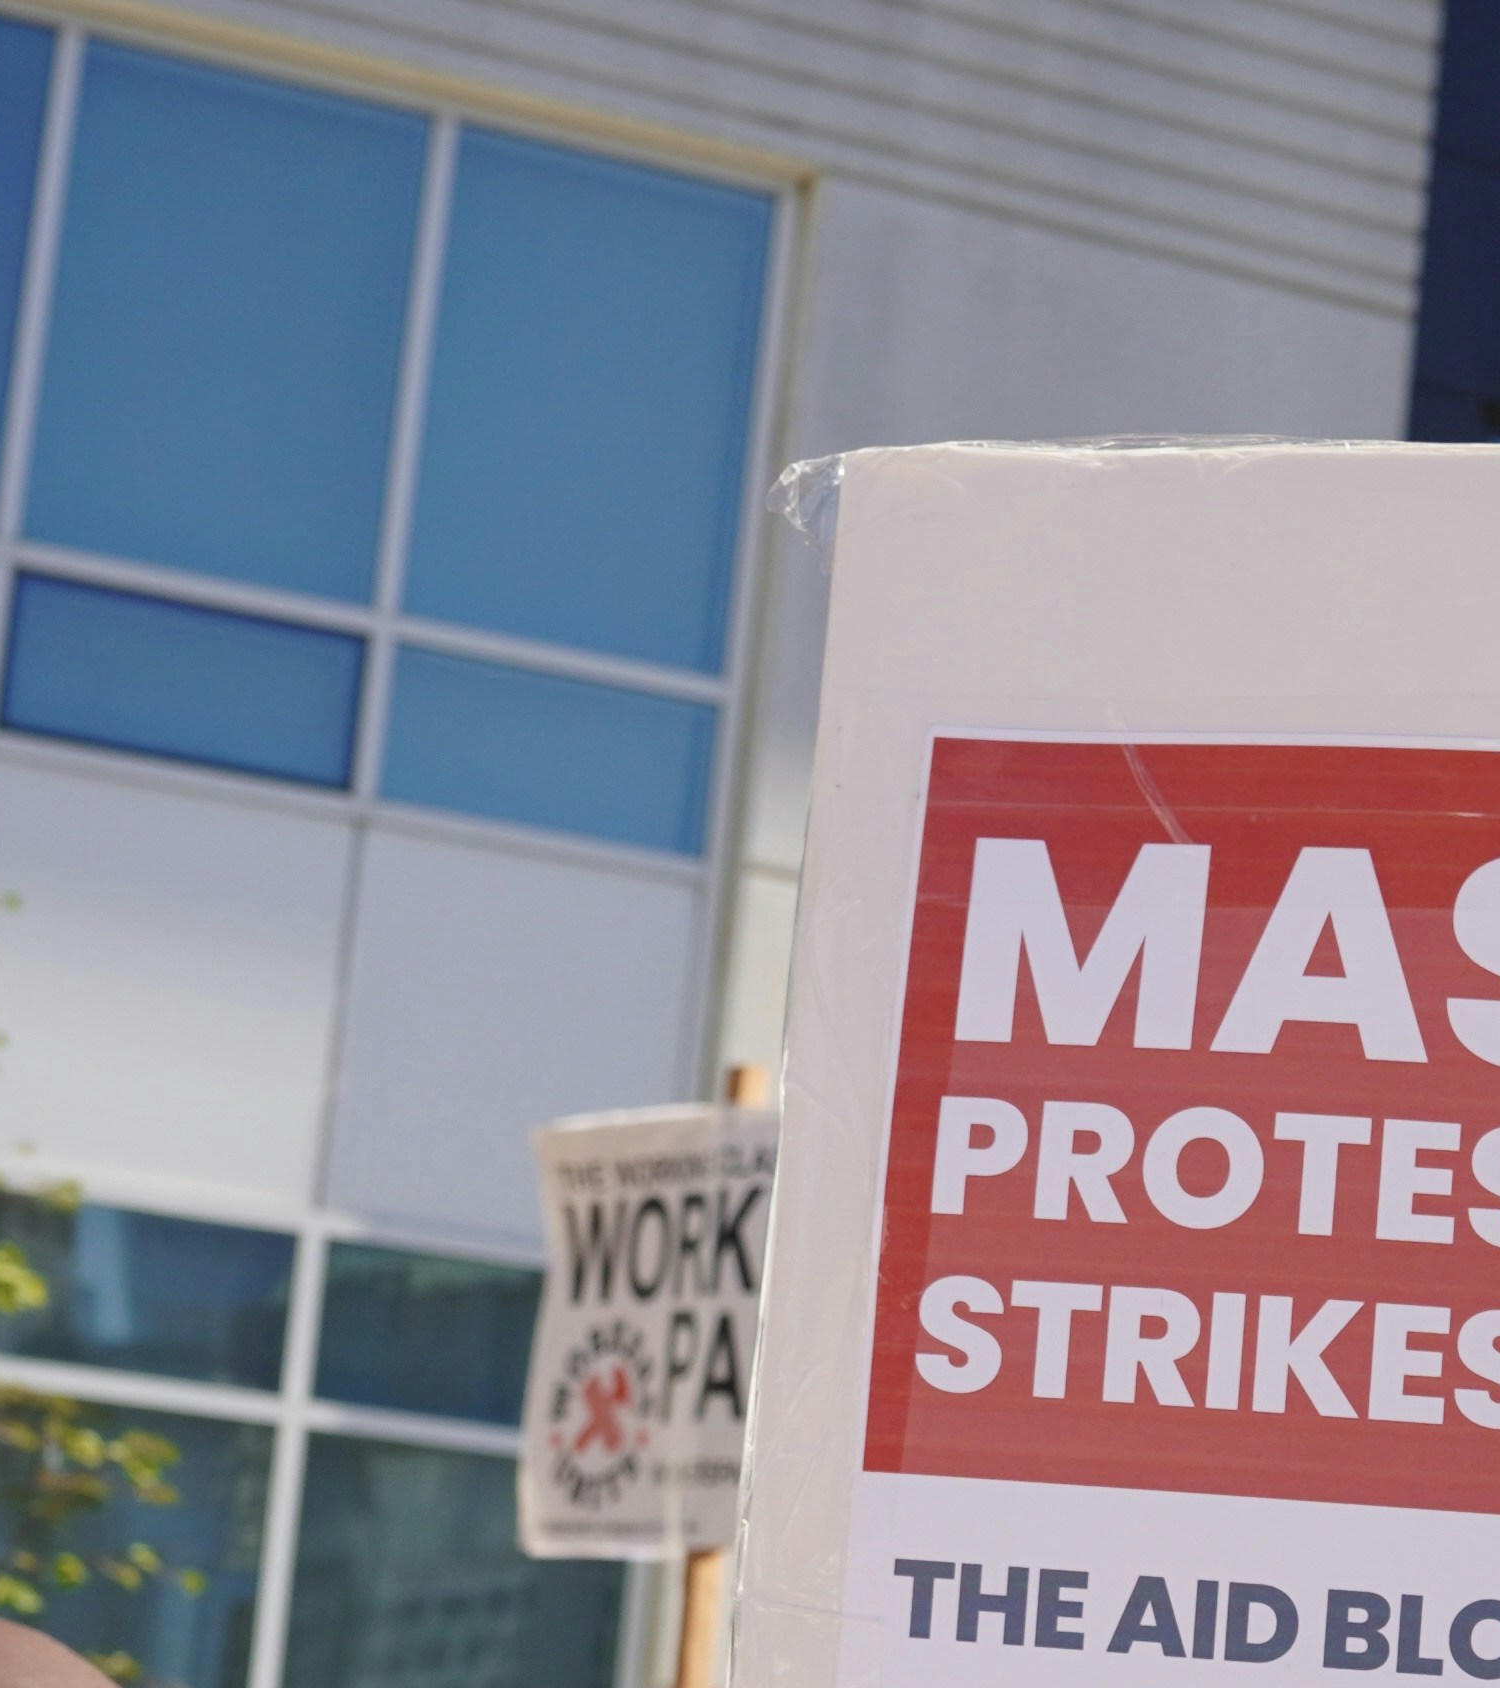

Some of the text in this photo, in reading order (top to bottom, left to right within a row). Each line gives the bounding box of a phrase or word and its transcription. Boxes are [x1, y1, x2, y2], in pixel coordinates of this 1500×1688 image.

[564, 1185, 765, 1304] WORK
[892, 1557, 1090, 1652] THE
[1105, 1574, 1300, 1665] AID
